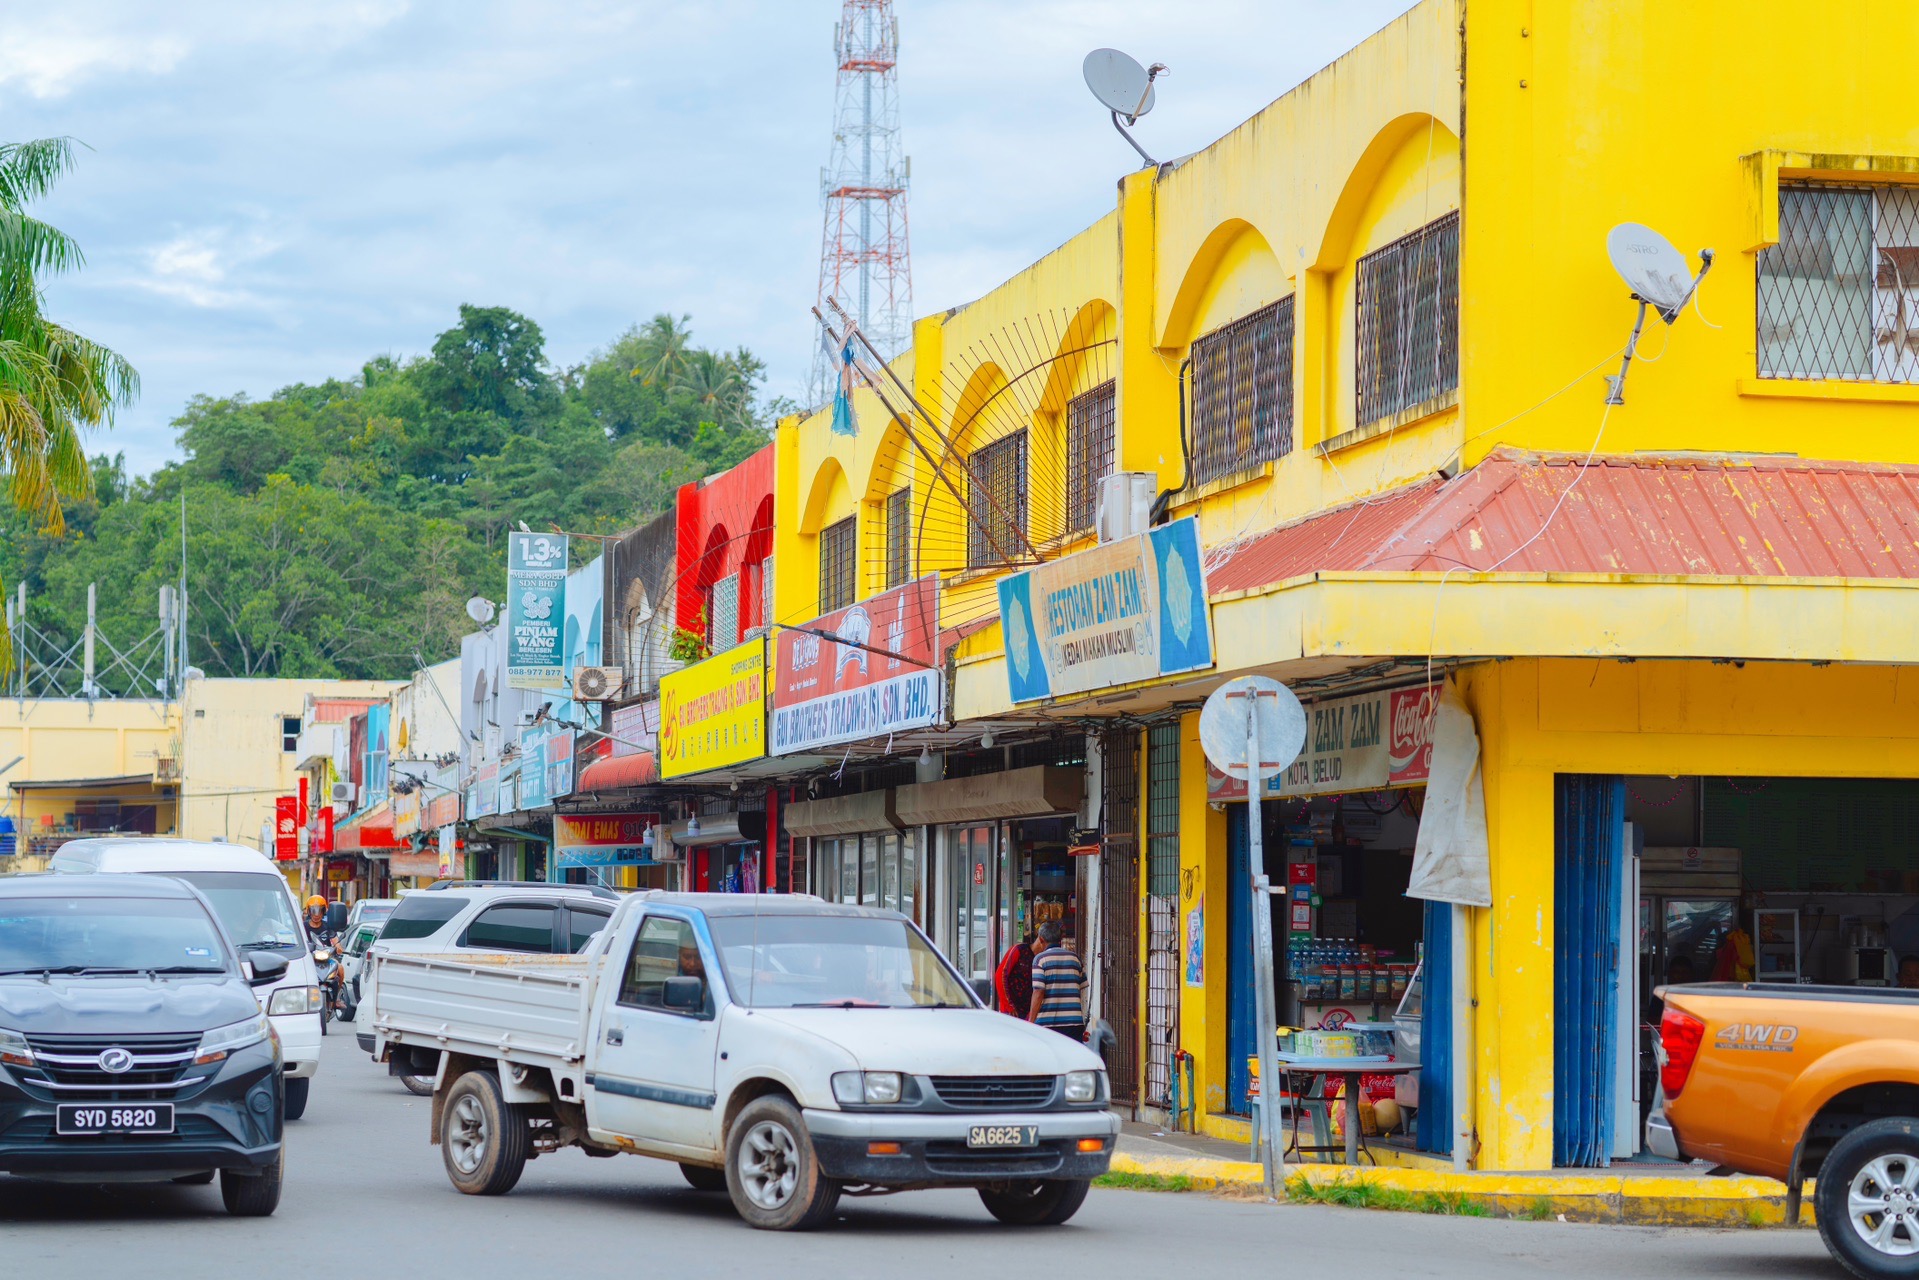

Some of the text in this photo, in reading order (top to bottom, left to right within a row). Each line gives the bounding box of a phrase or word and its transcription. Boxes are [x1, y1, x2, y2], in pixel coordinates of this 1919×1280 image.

[519, 537, 562, 561] 1.3%
[538, 580, 558, 588] BHD
[1092, 574, 1118, 624] ZAM
[1115, 567, 1142, 618] ZAM
[514, 626, 559, 638] PINJAM
[516, 637, 556, 649] WANG
[1061, 627, 1137, 671] (KEDAI MAKAN MUSLIM)
[508, 668, 562, 677] 088-977 877
[776, 712, 789, 748] GUI
[789, 701, 829, 744] BROTHERS
[830, 692, 867, 736] TRADING
[869, 685, 880, 733] (S)
[882, 682, 901, 725] SDN.
[904, 676, 930, 720] BHD.
[1315, 706, 1345, 753] ZAM
[1350, 700, 1381, 749] ZAM
[1287, 757, 1342, 786] KOTA BELUD
[594, 821, 620, 840] EMAS
[1716, 1023, 1799, 1044] 4WD
[74, 1109, 156, 1127] SYD 5820
[1027, 1126, 1037, 1144] Y
